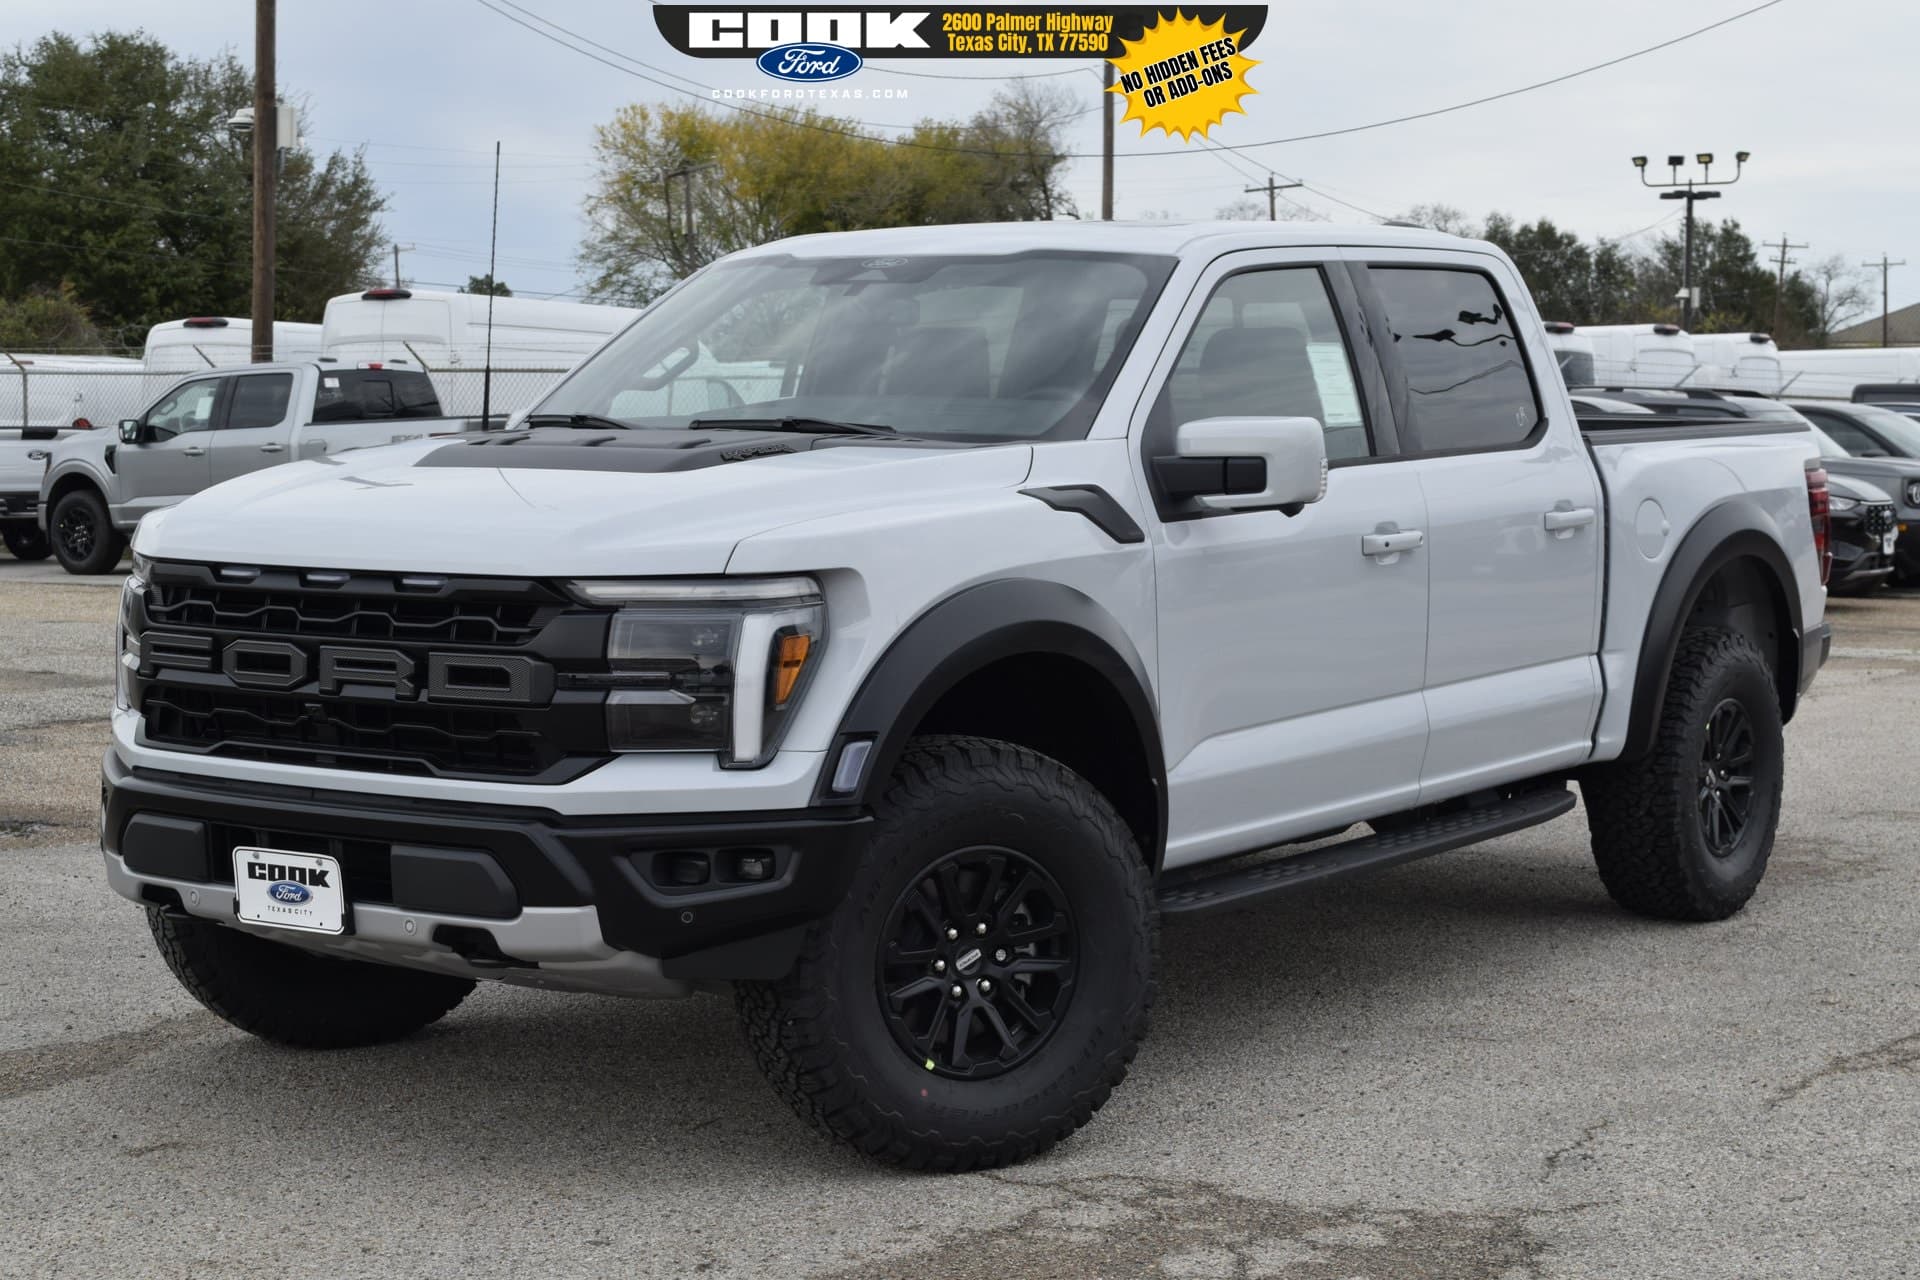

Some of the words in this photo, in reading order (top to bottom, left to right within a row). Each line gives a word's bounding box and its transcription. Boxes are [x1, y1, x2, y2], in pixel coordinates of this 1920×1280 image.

[138, 630, 557, 706] FORD
[247, 861, 331, 888] COOK
[275, 884, 303, 901] Ford
